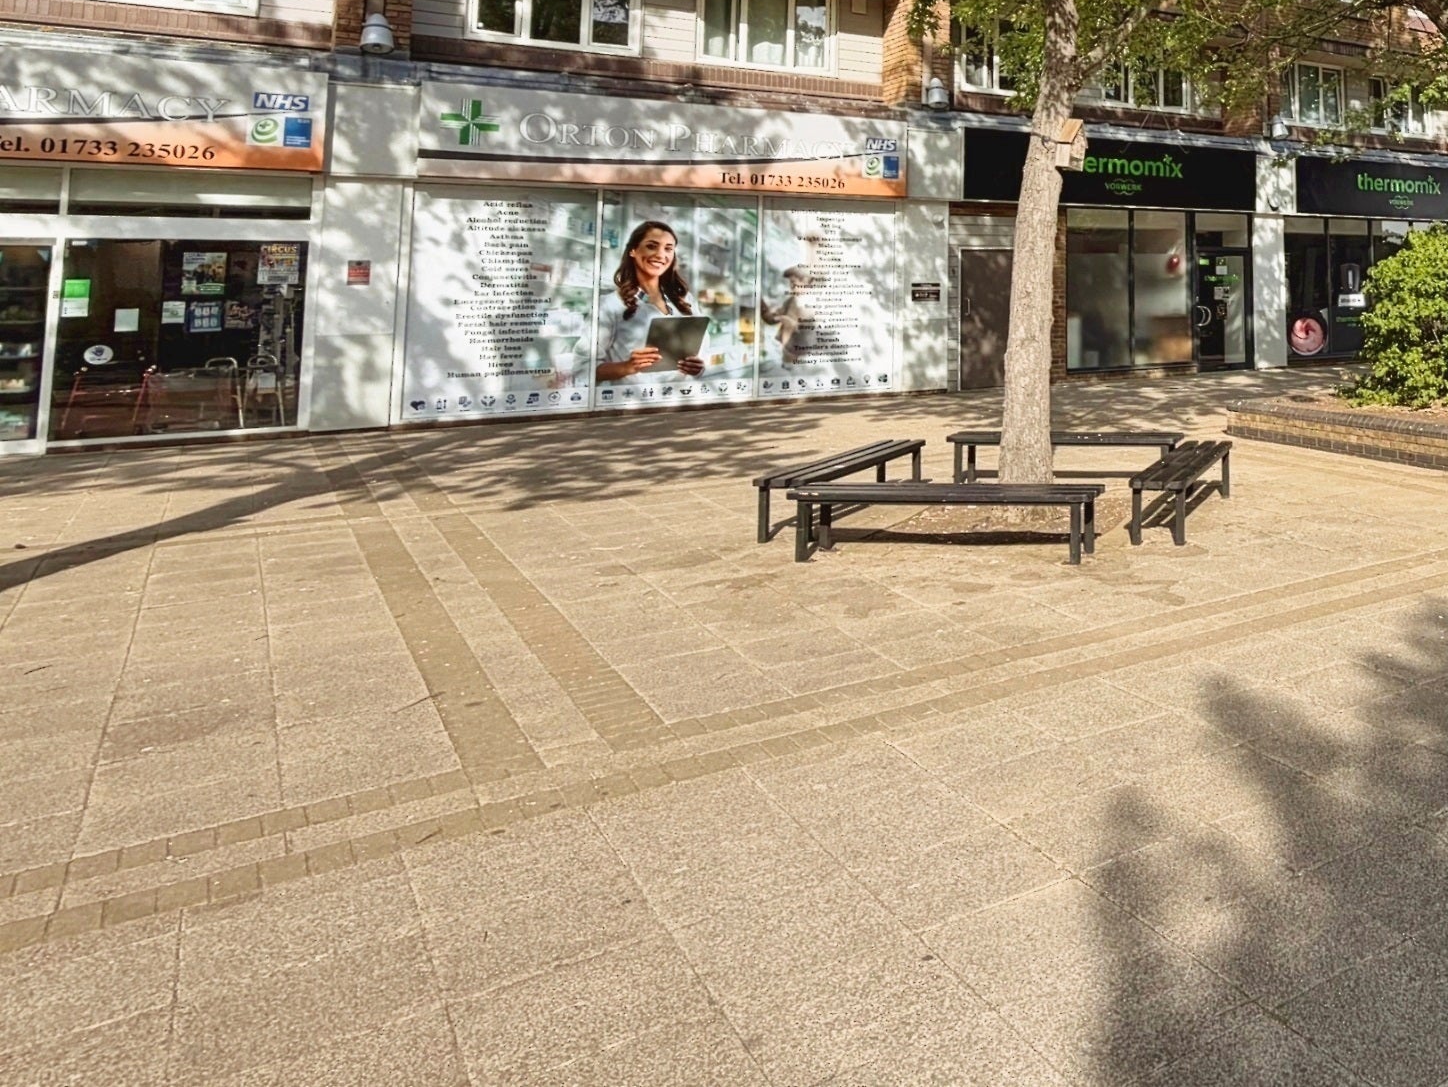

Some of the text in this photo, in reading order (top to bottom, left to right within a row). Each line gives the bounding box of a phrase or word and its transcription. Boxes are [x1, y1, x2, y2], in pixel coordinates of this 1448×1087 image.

[255, 93, 308, 111] NHS
[0, 136, 216, 160] el. 01733 235026
[519, 113, 857, 160] ORTON PHARMACY
[866, 138, 897, 152] NHS
[1084, 154, 1183, 178] ermomix
[720, 172, 845, 189] Tel. 01733 235026
[1357, 172, 1441, 195] thermomix
